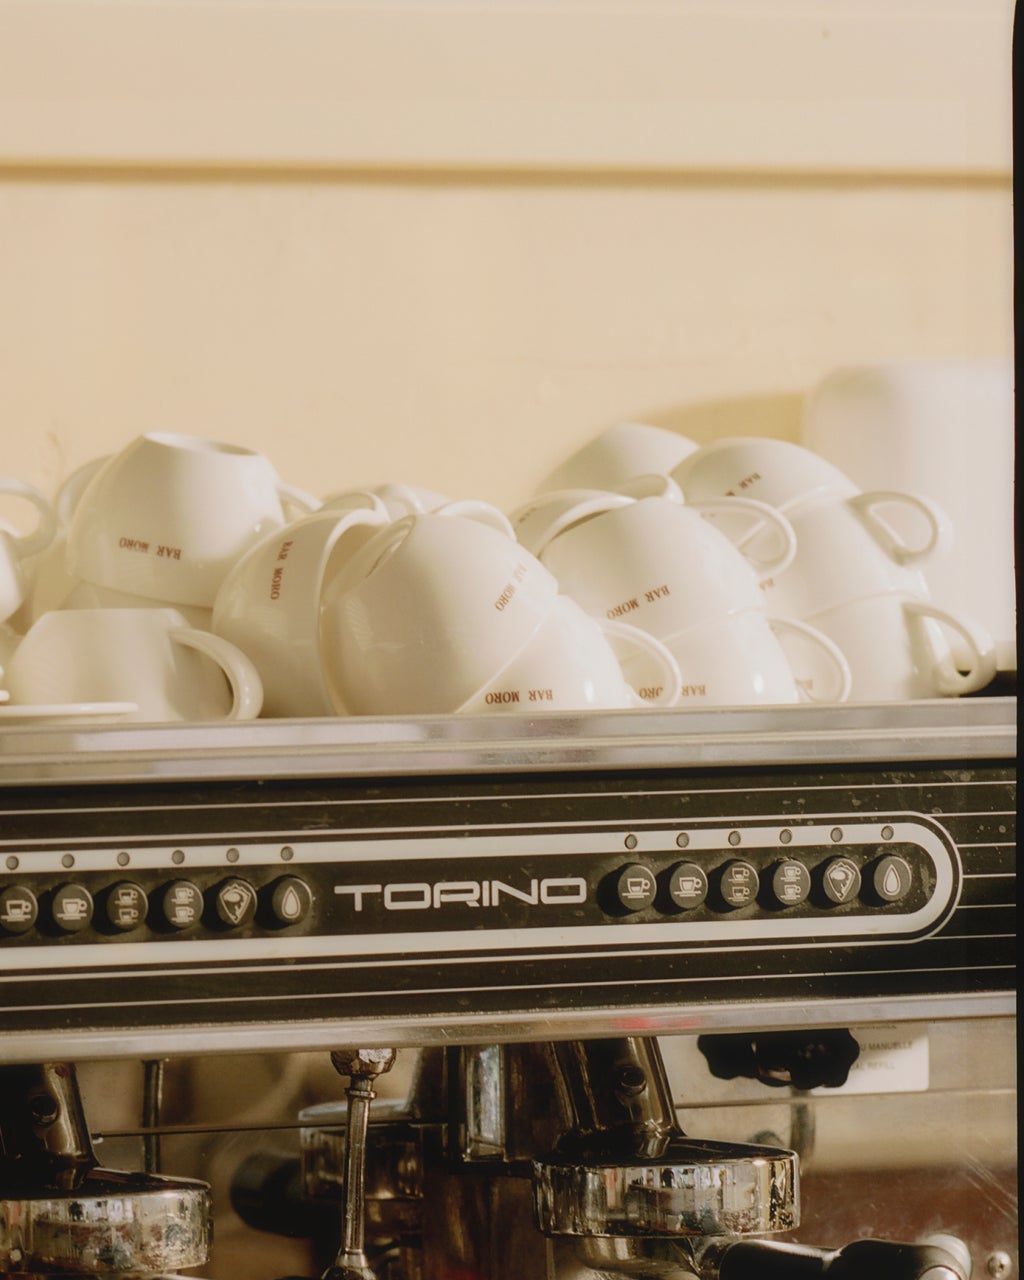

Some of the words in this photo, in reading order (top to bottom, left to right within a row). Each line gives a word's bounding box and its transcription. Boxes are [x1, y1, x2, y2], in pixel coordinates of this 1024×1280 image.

[119, 537, 149, 554] MORO
[156, 545, 182, 560] BAR
[277, 541, 294, 561] BAR
[271, 567, 283, 600] MORO
[494, 583, 517, 612] MORO
[644, 585, 670, 603] BAR
[606, 597, 640, 620] MORO
[485, 691, 520, 705] MORO
[528, 689, 553, 701] BAR
[681, 685, 707, 697] BAR
[334, 877, 587, 911] TORINO
